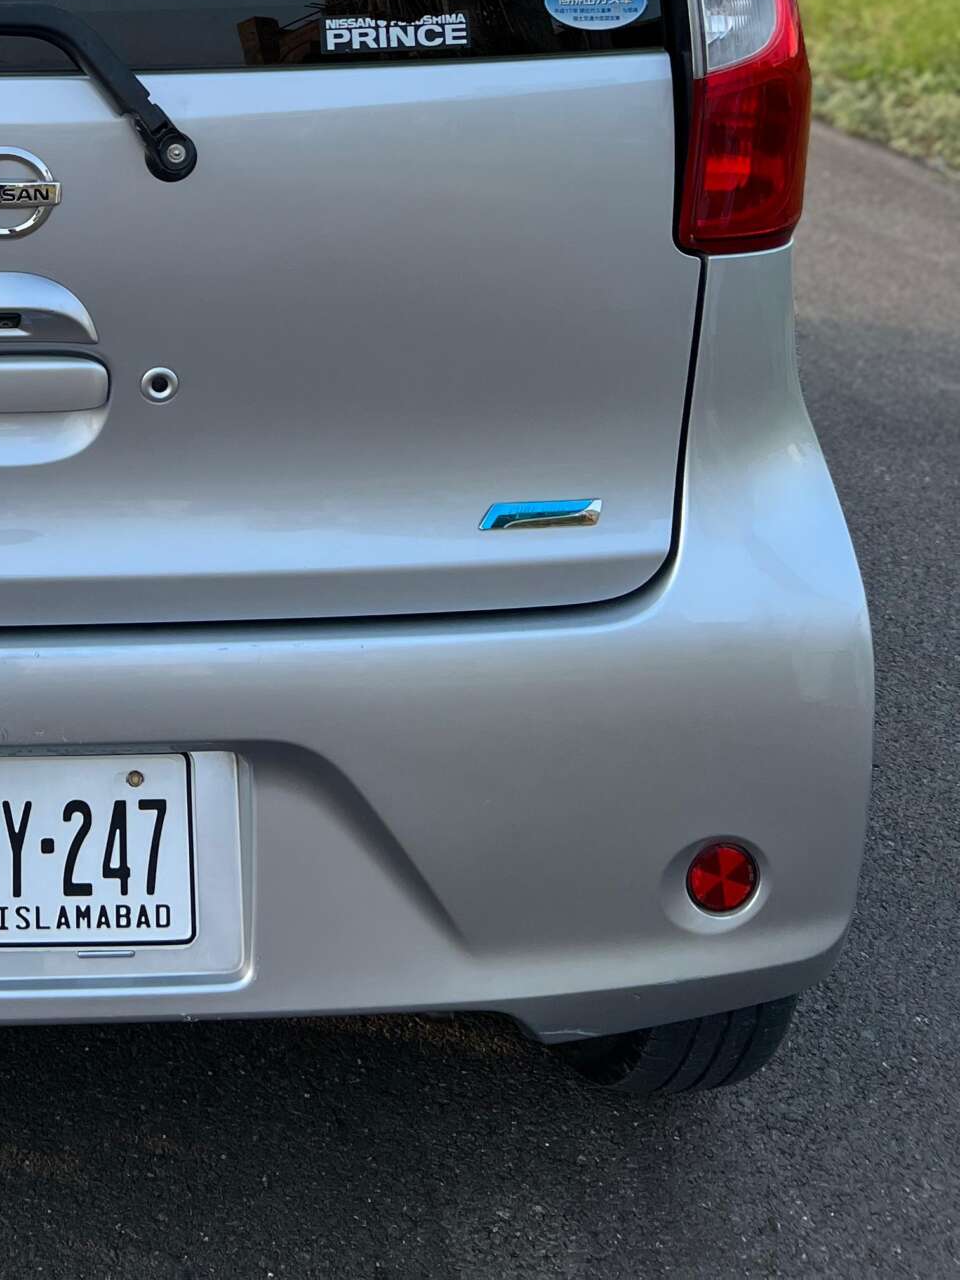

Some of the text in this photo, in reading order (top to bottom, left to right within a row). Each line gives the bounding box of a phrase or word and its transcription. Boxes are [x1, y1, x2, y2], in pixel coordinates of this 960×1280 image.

[325, 13, 466, 29] NISSAN SHIMA
[326, 23, 468, 50] PRINCE
